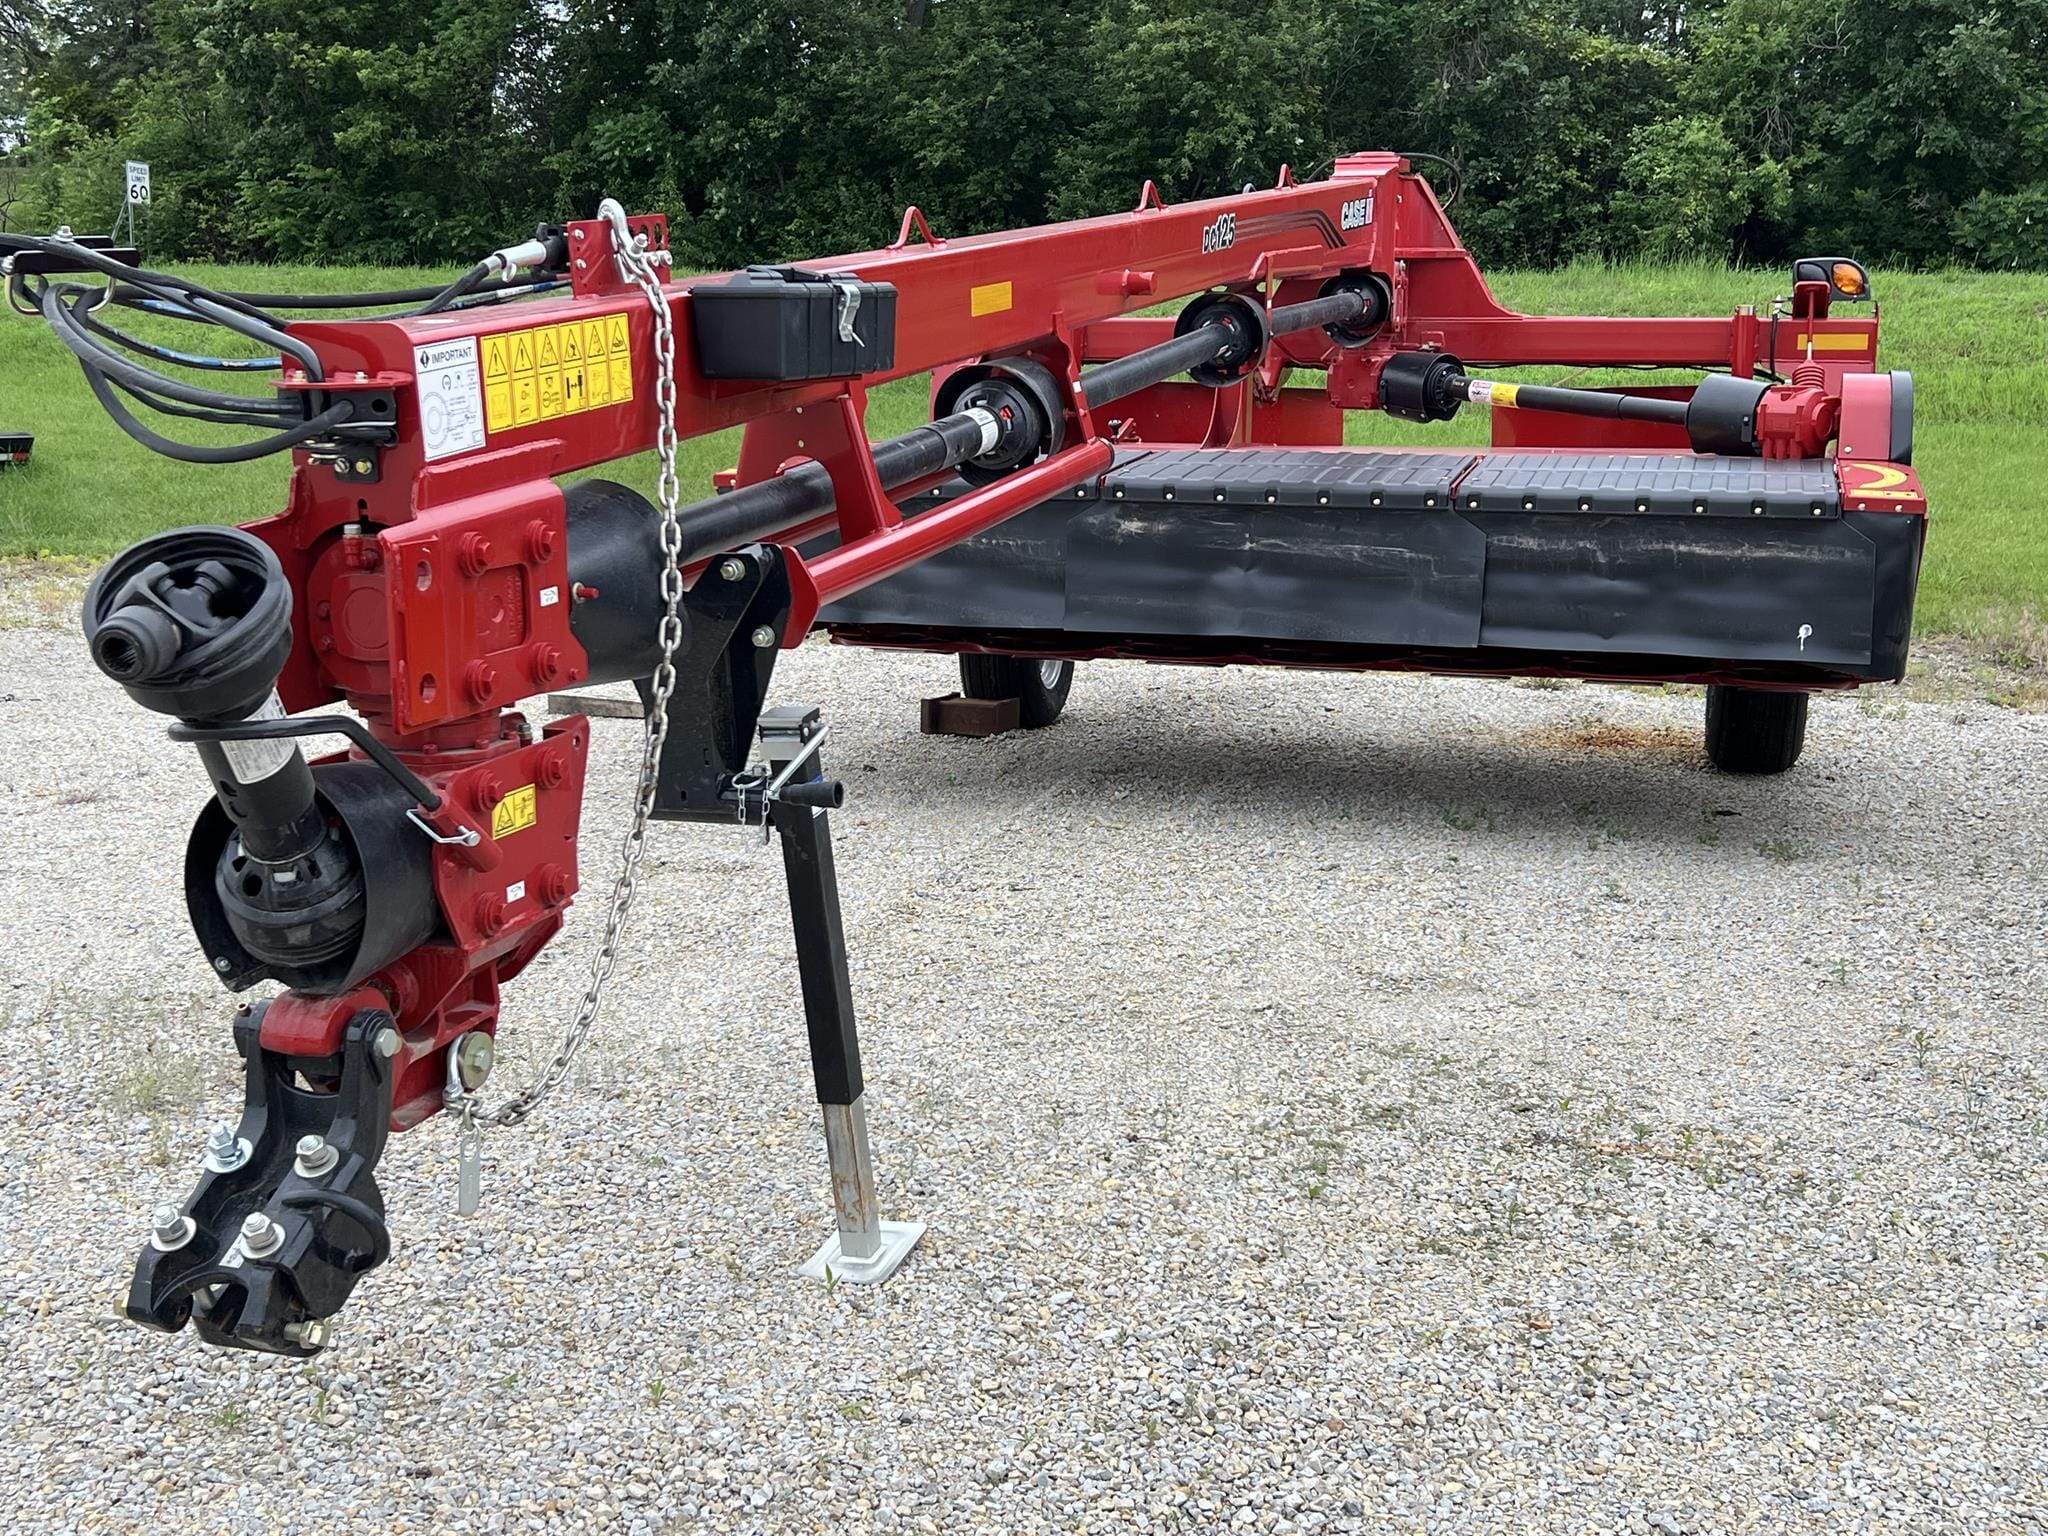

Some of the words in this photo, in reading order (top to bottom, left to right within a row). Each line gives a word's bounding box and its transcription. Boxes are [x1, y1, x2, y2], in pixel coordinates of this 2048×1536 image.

[129, 166, 148, 175] SPEED
[130, 184, 149, 200] 60
[1341, 199, 1366, 231] CASE
[1202, 213, 1236, 254] DC125
[431, 346, 472, 364] IMPORTANT
